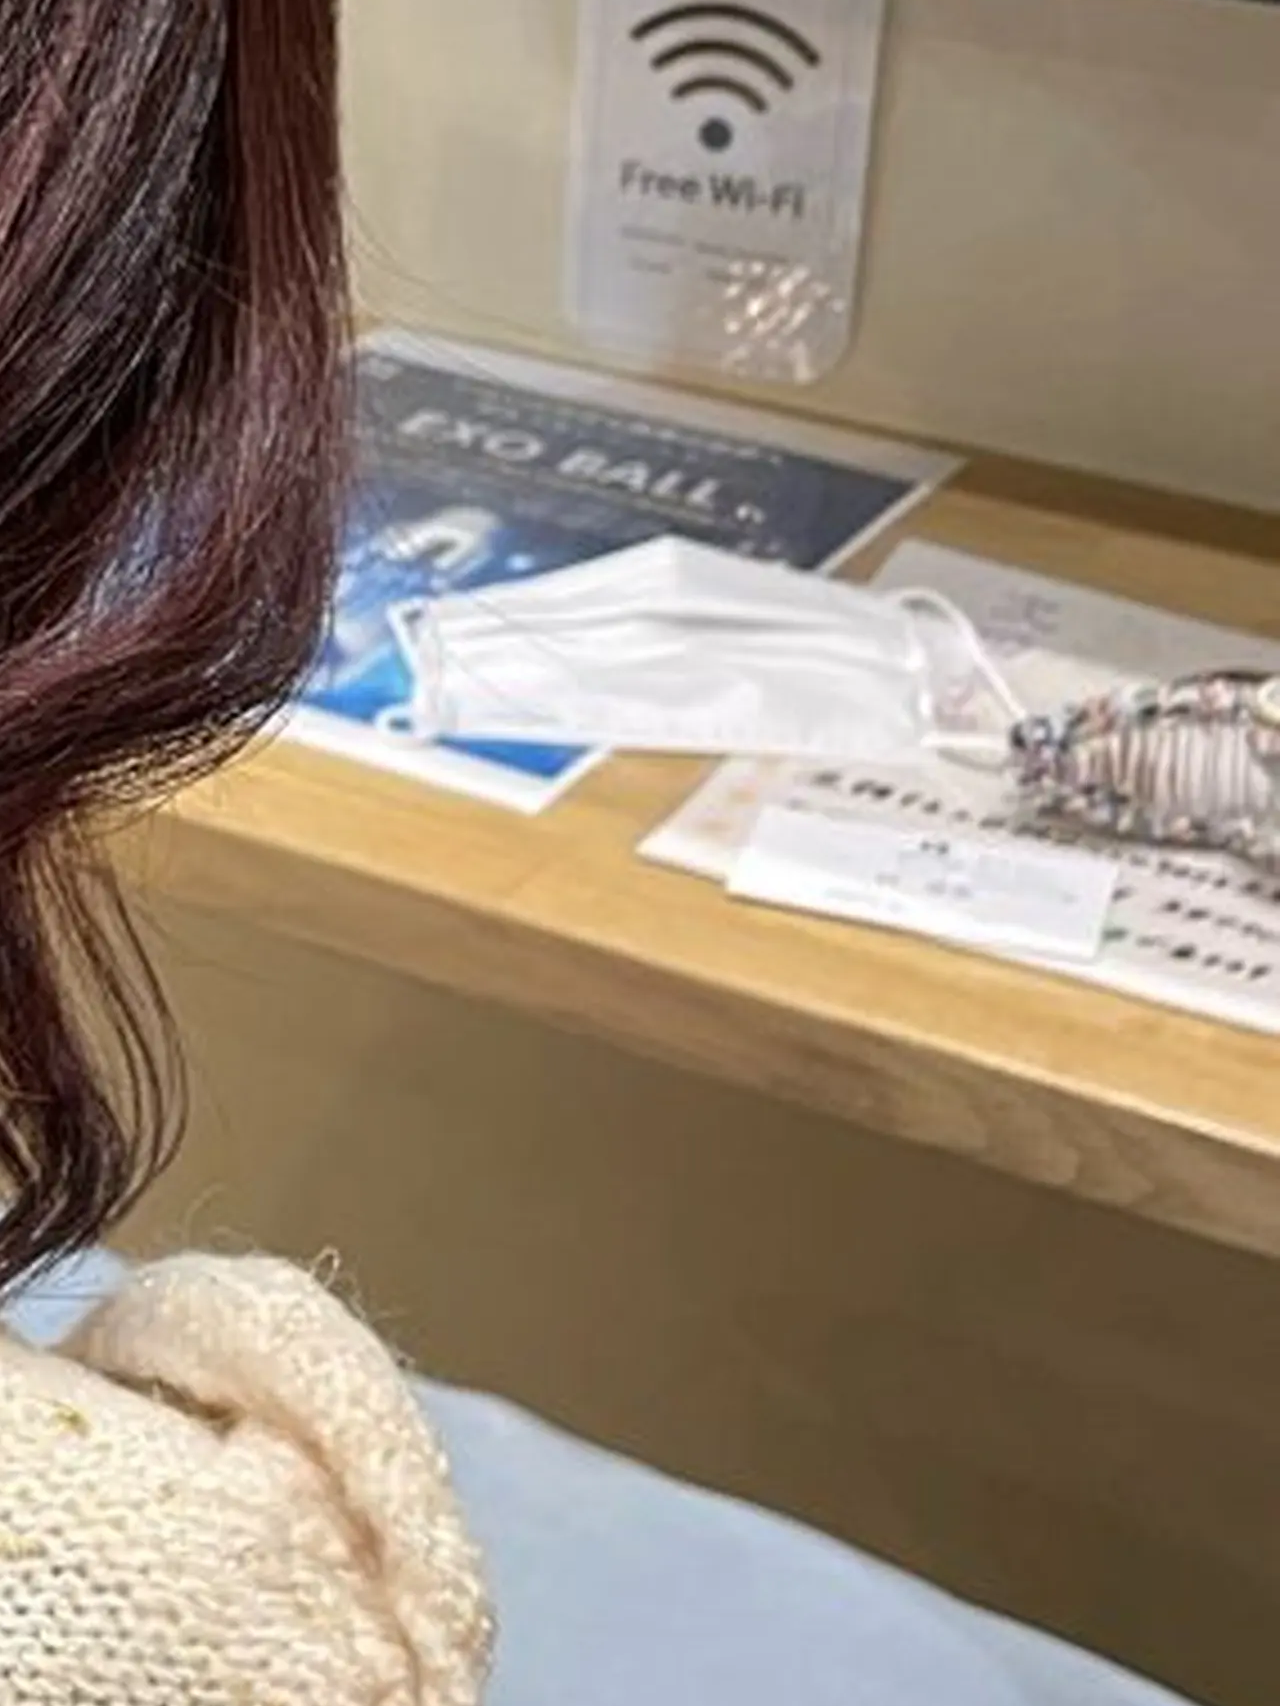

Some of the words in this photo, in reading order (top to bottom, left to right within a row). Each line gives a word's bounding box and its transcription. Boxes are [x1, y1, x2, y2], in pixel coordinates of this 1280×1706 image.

[620, 160, 701, 204] Free
[708, 172, 805, 219] Wi-Fi
[557, 447, 722, 508] BALL
